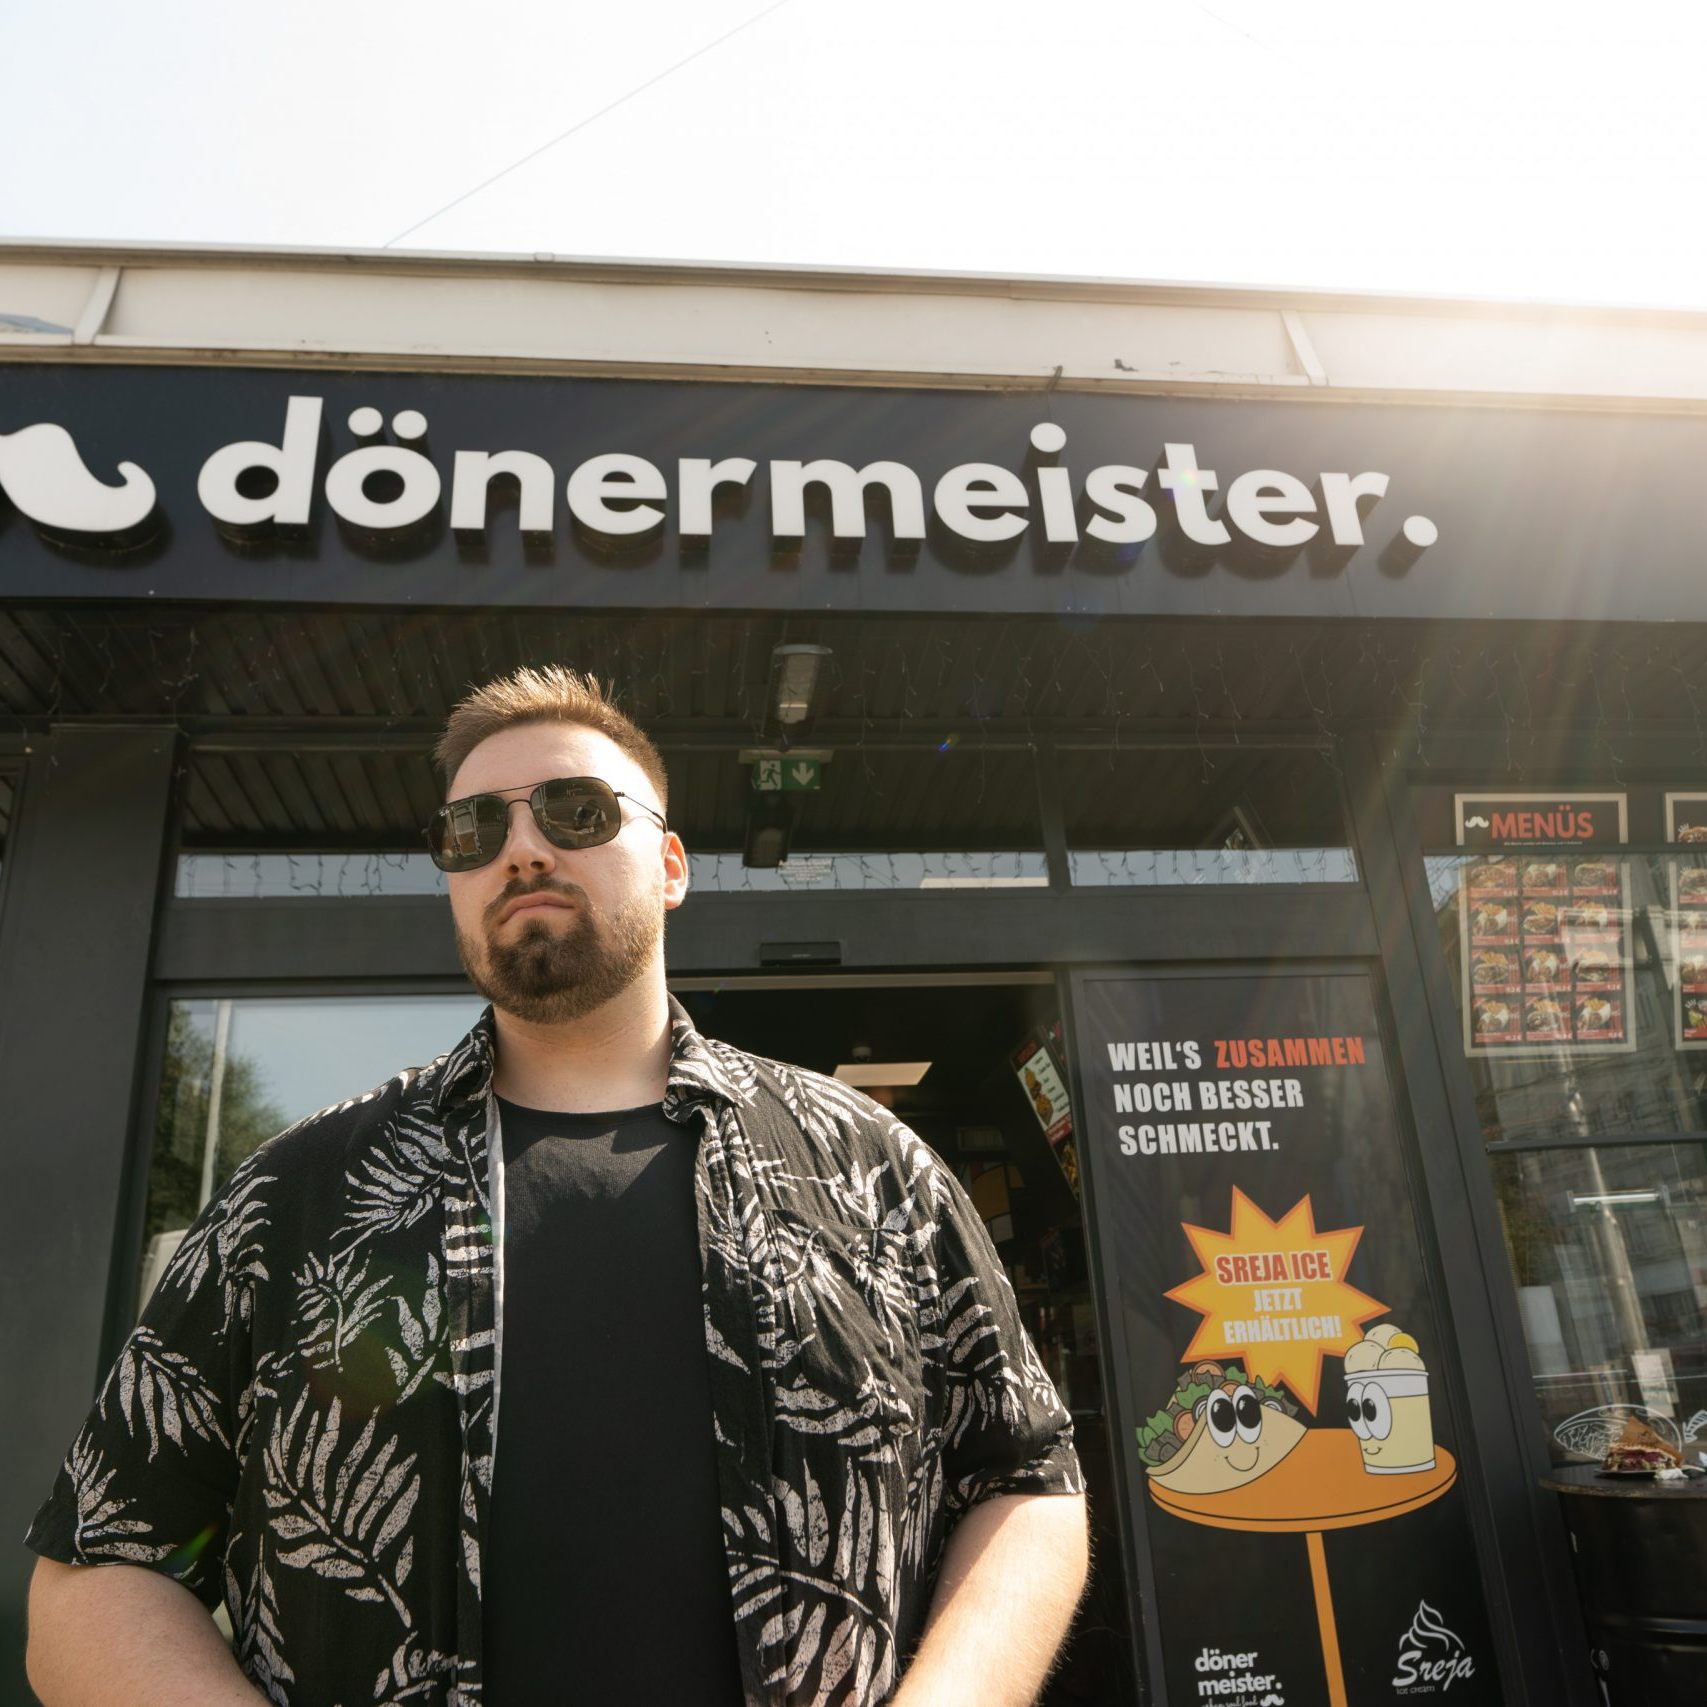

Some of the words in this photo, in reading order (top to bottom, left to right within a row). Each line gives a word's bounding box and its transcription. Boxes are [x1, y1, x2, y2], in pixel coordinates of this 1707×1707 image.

[197, 396, 1439, 547] dönermeister.
[1491, 805, 1594, 838] MENÜS
[1215, 1036, 1366, 1069] ZUSAMMEN
[1113, 1081, 1193, 1113] NOCH
[1199, 1078, 1304, 1111] BESSER
[1118, 1120, 1280, 1156] SCHMECKT.
[1215, 1253, 1289, 1285] SREJA
[1291, 1250, 1331, 1281] ICE
[1254, 1287, 1303, 1313] JETZT
[1223, 1315, 1343, 1345] ERHÄLTLICH!
[1195, 1647, 1258, 1672] döner
[1391, 1650, 1476, 1691] Sreja
[1198, 1670, 1283, 1696] meister.
